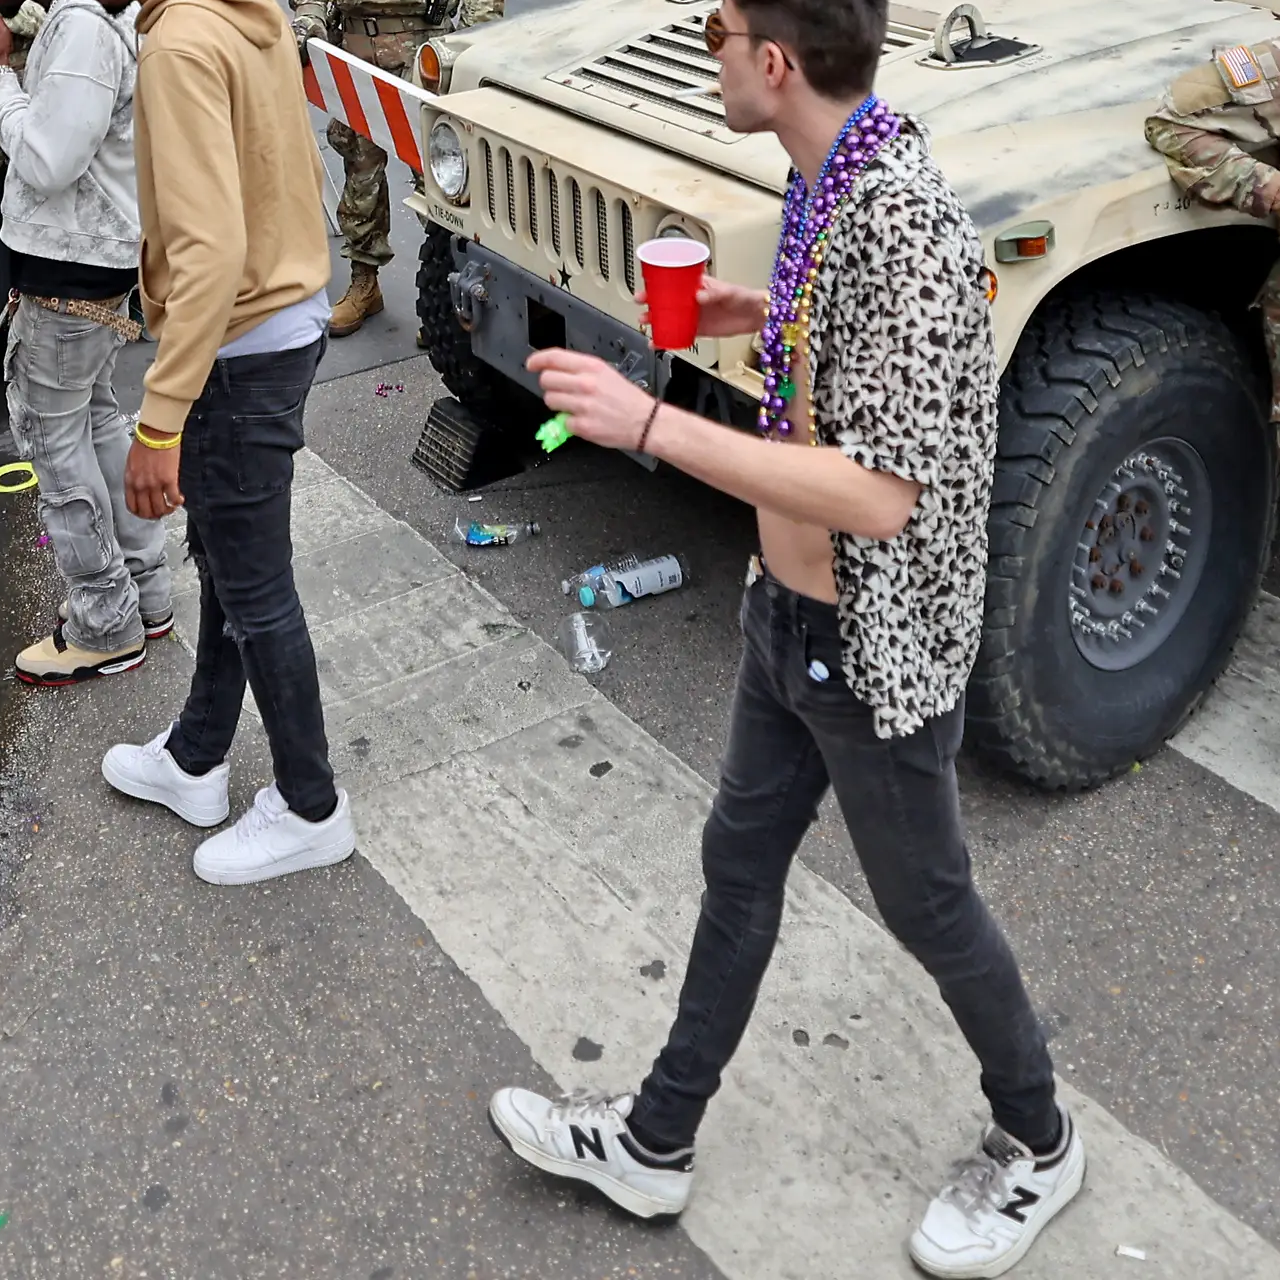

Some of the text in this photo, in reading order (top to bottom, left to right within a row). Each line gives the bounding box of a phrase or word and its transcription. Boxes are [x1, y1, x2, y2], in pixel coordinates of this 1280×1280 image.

[434, 204, 464, 229] TIE-DOWN
[569, 1123, 609, 1162] N
[997, 1185, 1041, 1224] N
